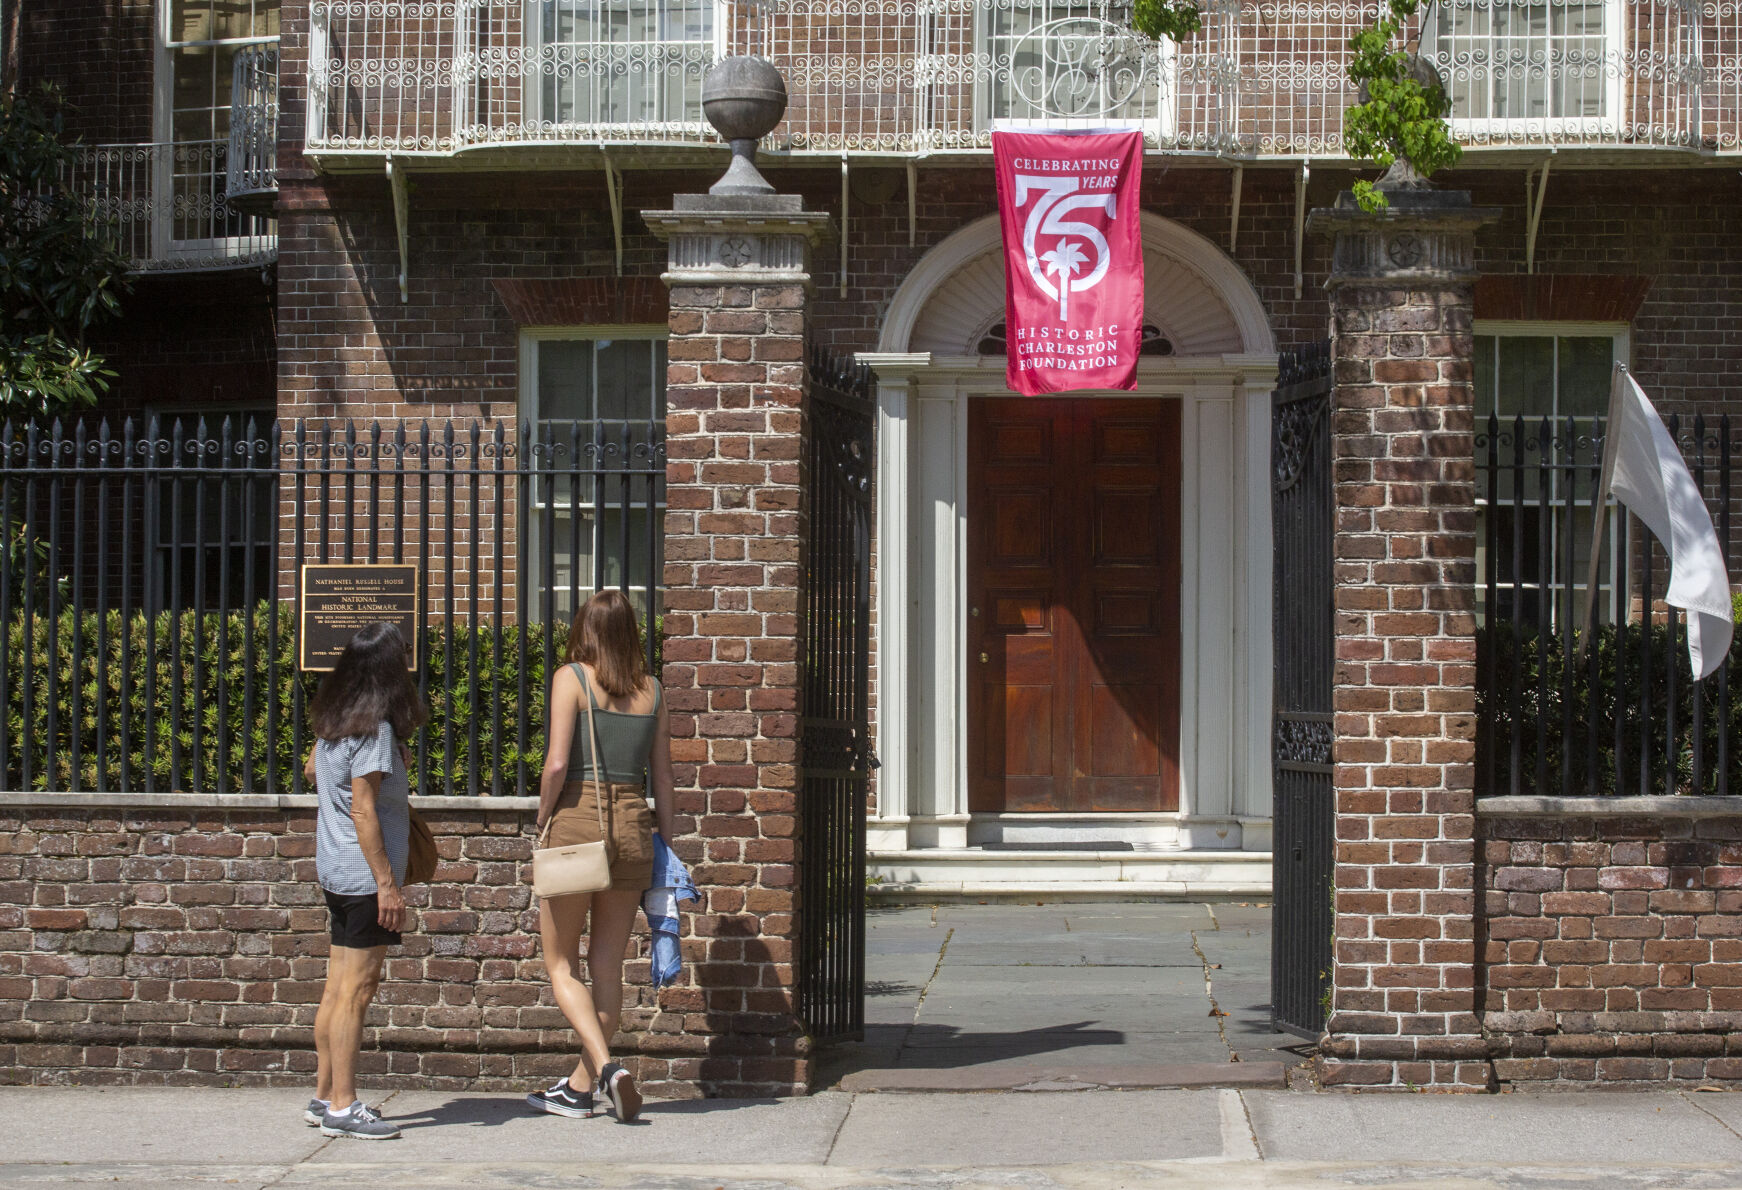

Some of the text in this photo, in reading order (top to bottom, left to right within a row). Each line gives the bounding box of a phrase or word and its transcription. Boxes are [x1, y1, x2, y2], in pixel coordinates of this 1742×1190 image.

[1014, 157, 1120, 171] CELEBRATING
[1015, 174, 1118, 302] 75 YEARS
[1017, 324, 1118, 341] HISTORIC
[1018, 339, 1117, 355] CHARLESTON
[1019, 354, 1118, 371] FOUNDATION
